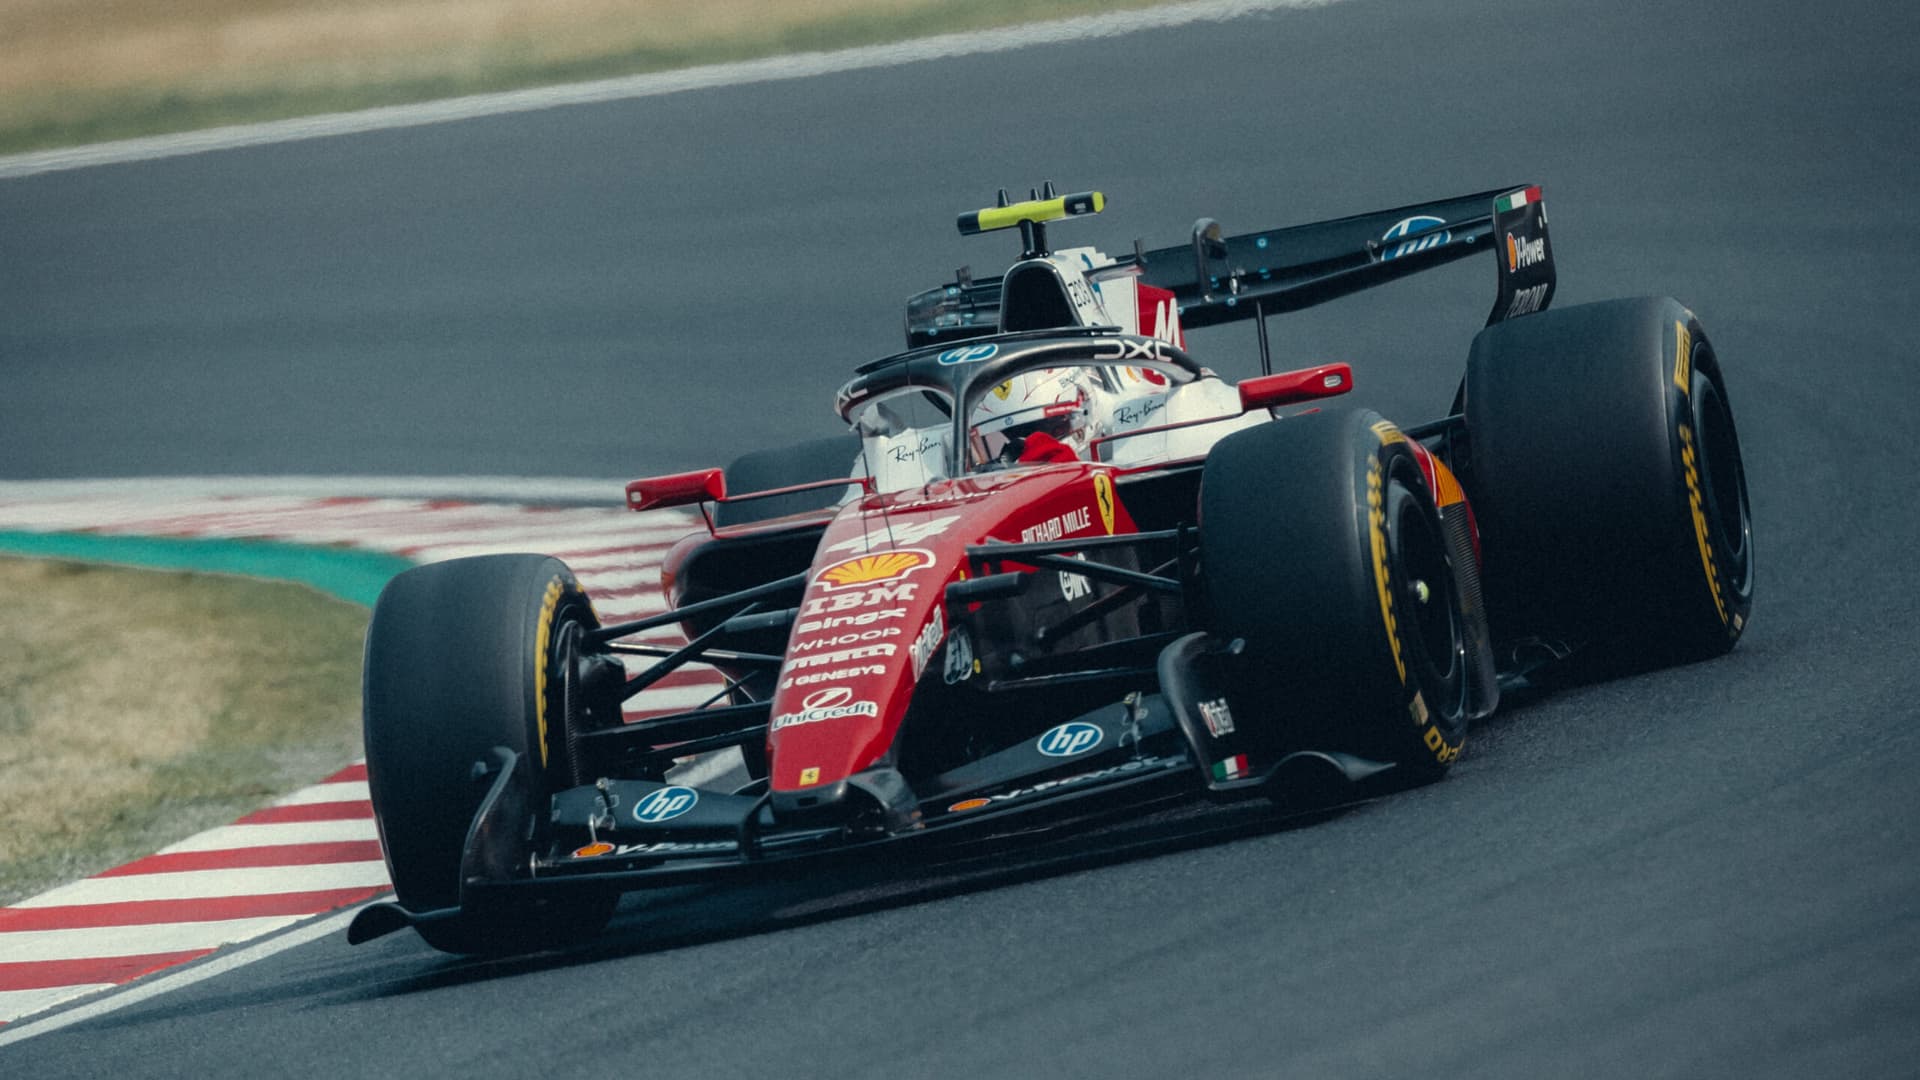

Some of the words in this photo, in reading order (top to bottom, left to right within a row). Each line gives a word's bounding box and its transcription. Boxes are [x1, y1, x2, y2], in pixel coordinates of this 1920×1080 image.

[943, 343, 994, 365] hp
[1093, 338, 1173, 362] DXC
[1112, 400, 1165, 424] Ray-Ban
[887, 437, 942, 463] Ray-Ban
[1021, 515, 1063, 545] RICHARD
[1061, 505, 1092, 535] MILLE
[801, 582, 919, 618] IBM
[789, 627, 902, 653] WHOOP
[795, 664, 887, 686] GENESYS
[773, 702, 875, 730] UniCredit
[1042, 723, 1099, 757] hp
[637, 786, 694, 822] hp
